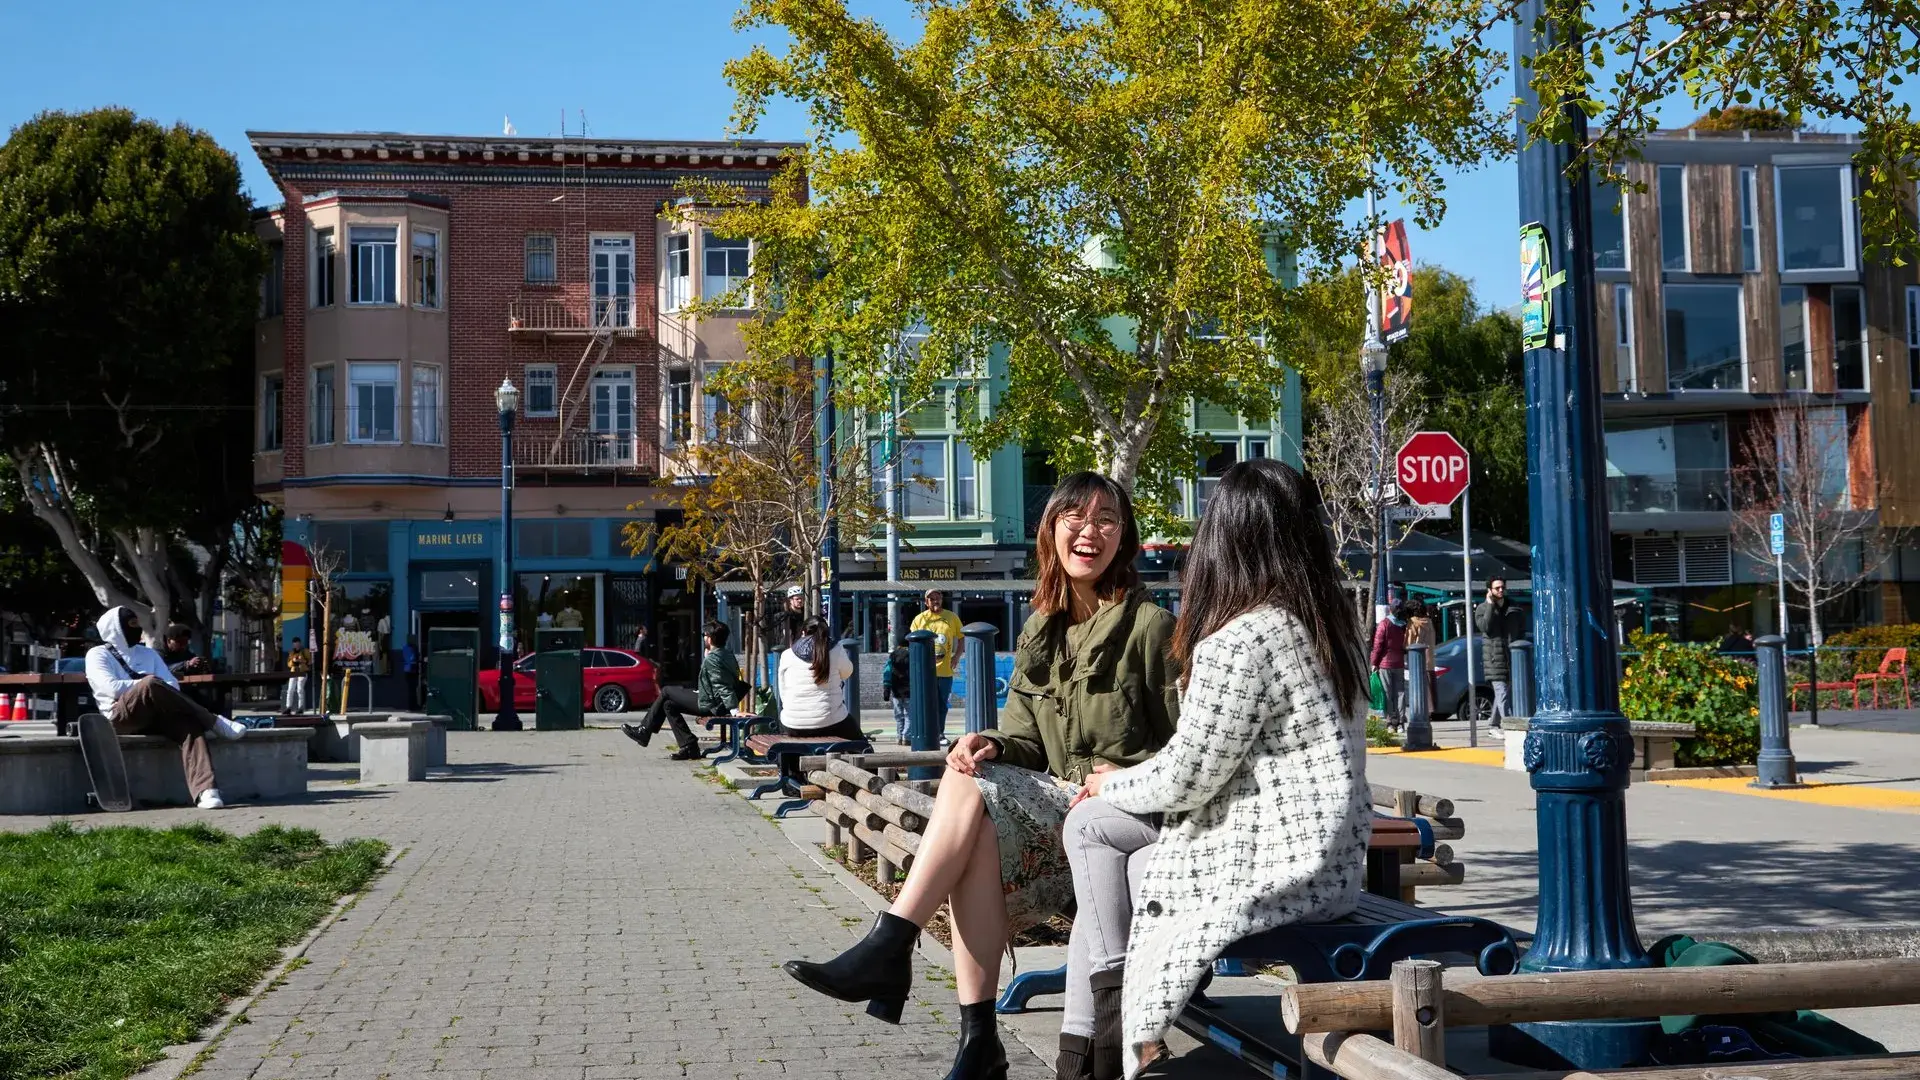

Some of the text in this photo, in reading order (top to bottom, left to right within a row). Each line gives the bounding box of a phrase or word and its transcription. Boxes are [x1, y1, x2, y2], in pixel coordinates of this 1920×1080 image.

[1402, 456, 1464, 483] STOP
[418, 533, 483, 545] MARINE LAYER
[899, 569, 955, 579] RASS TACKS
[334, 641, 376, 659] ARCHIVE
